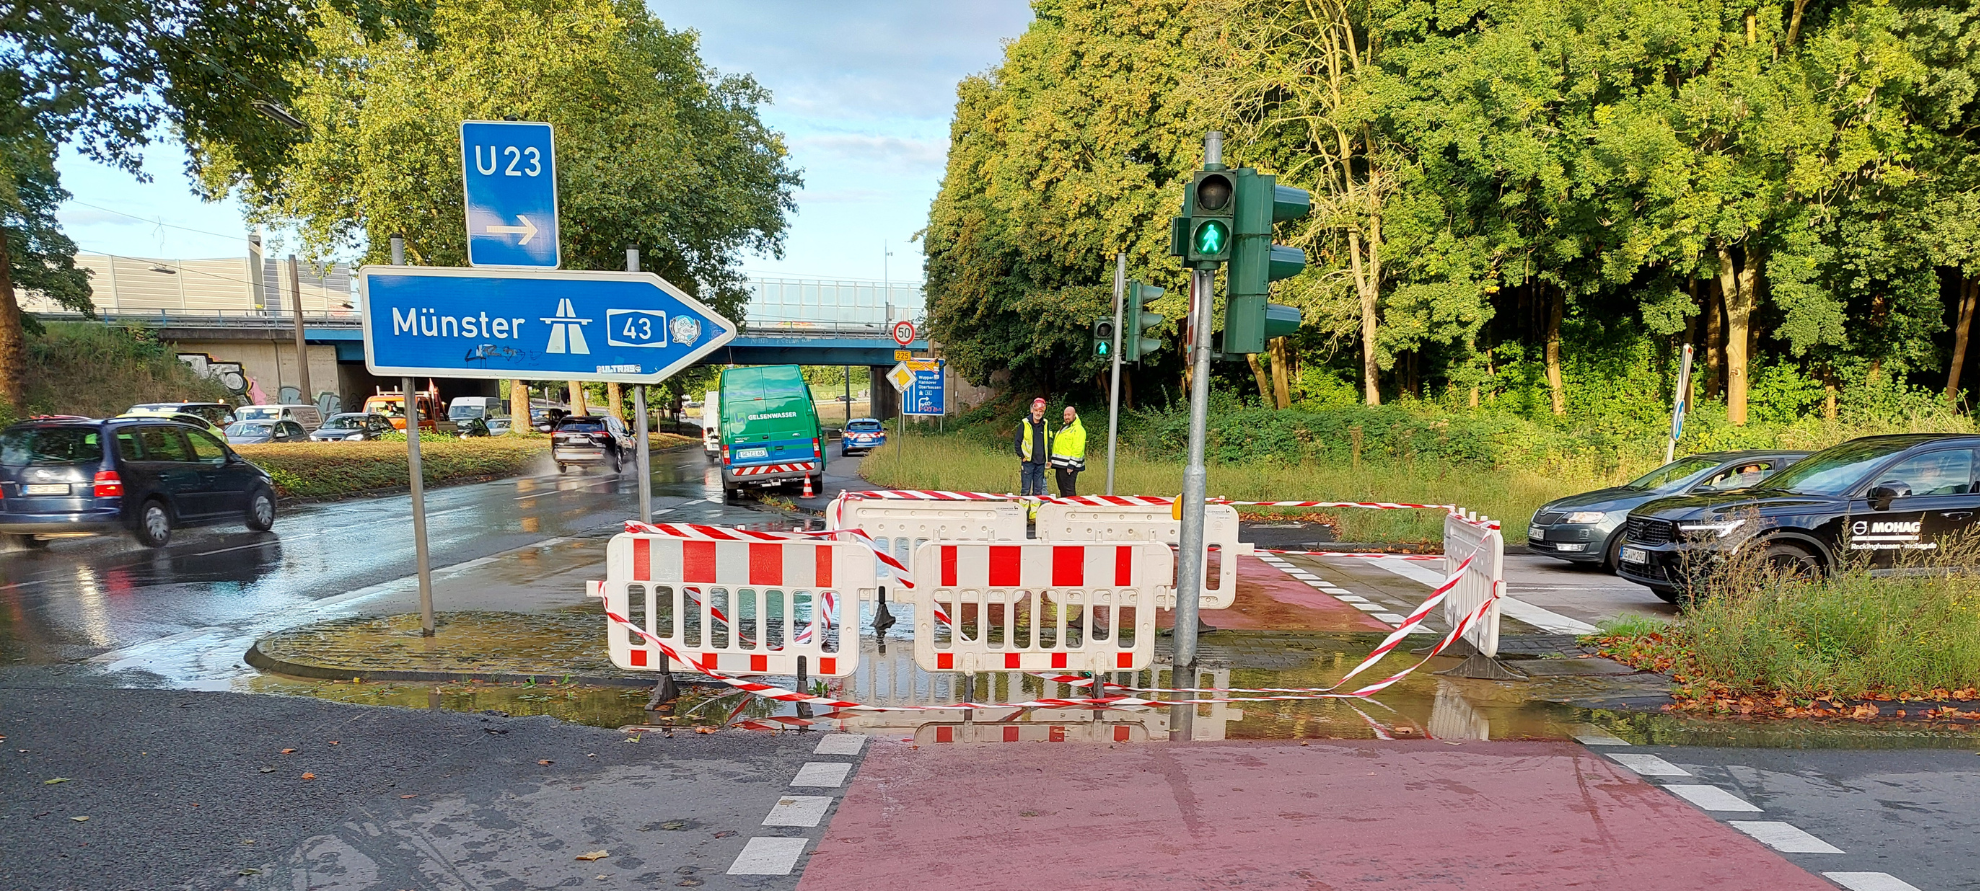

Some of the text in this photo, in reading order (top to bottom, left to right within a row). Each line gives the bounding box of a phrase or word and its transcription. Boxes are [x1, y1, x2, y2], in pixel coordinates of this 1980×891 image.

[475, 145, 541, 177] U 23
[392, 307, 525, 339] Münster
[622, 317, 652, 341] 43
[898, 327, 911, 339] 50
[896, 352, 909, 361] 225
[748, 411, 797, 421] GELSENWASSER
[1871, 521, 1920, 533] MOHAG
